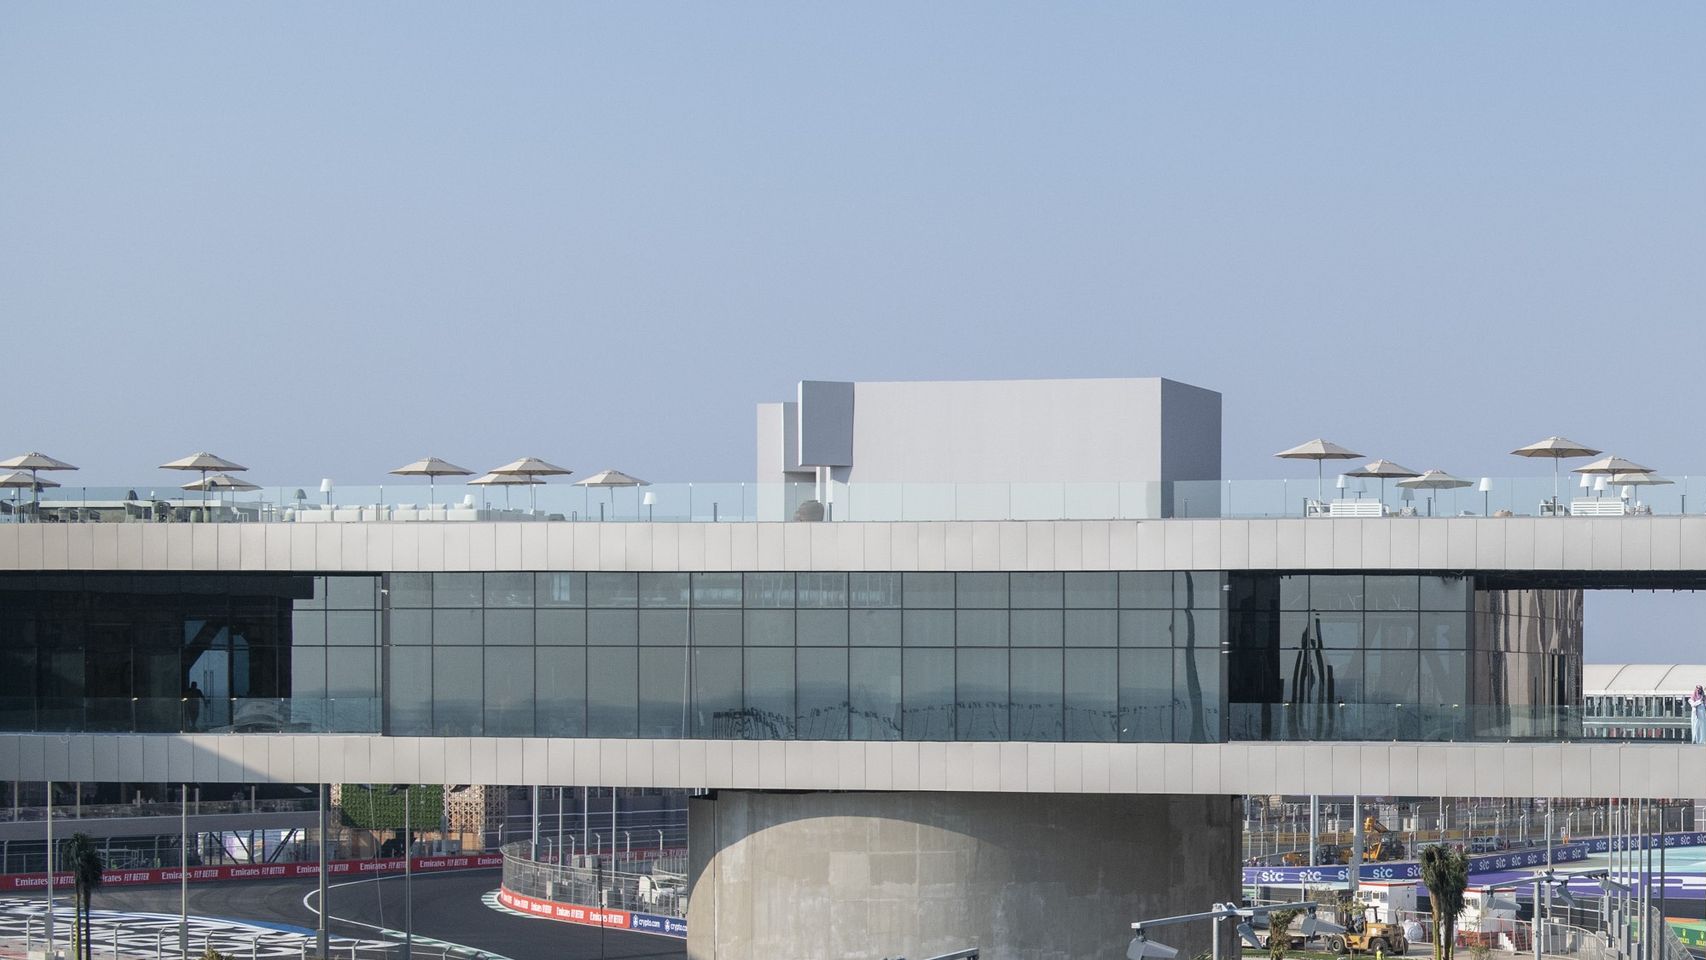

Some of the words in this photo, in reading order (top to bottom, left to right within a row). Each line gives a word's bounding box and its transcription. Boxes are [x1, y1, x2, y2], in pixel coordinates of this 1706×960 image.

[359, 862, 387, 871] Emirates
[420, 859, 446, 868] Emirates
[231, 867, 260, 877] Emirates
[1261, 870, 1284, 882] stc
[1338, 868, 1349, 880] st
[1373, 866, 1393, 879] stc
[15, 877, 48, 887] Emirates
[638, 918, 661, 929] crypto.com
